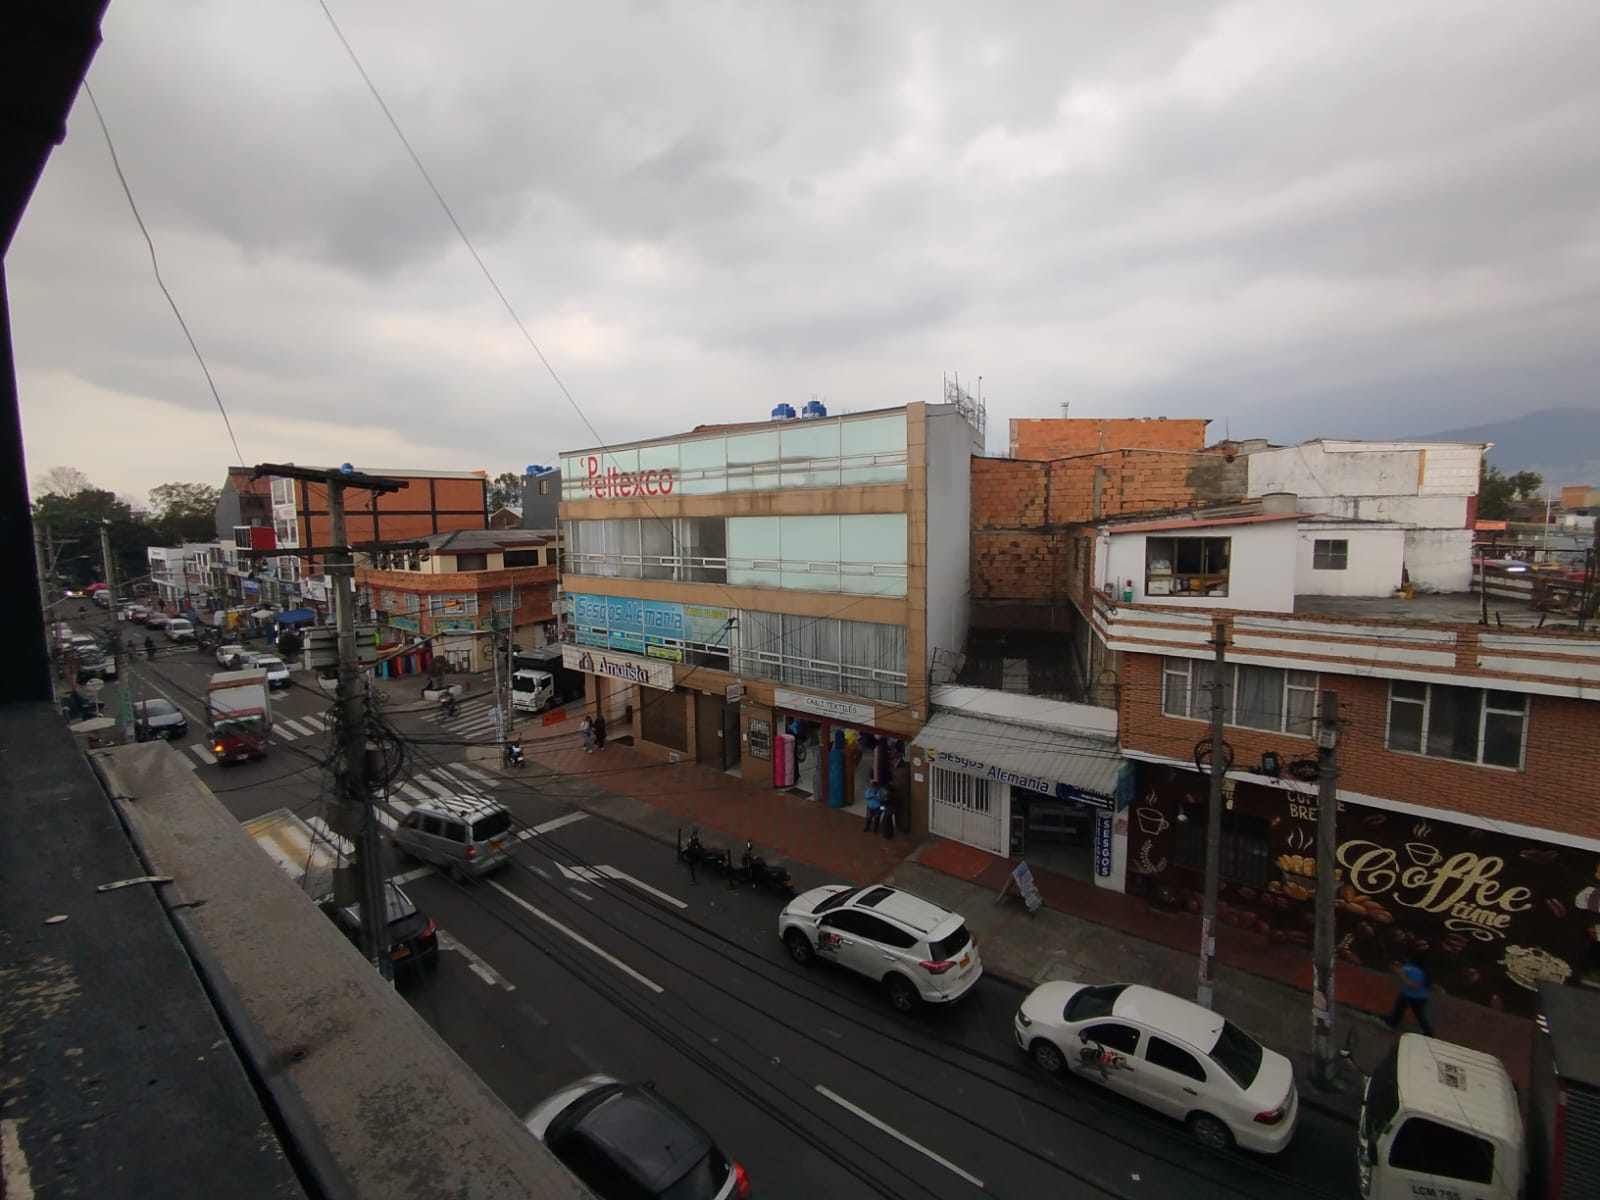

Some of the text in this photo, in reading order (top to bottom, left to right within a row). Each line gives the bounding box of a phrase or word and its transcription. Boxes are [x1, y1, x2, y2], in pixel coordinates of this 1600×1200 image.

[577, 596, 622, 624] Sesgos
[625, 600, 683, 630] Alemania
[600, 656, 650, 683] Amatista
[986, 765, 1050, 793] Alemania
[1100, 819, 1111, 876] SESGOS
[1335, 839, 1533, 913] Coffee
[1450, 900, 1512, 929] time
